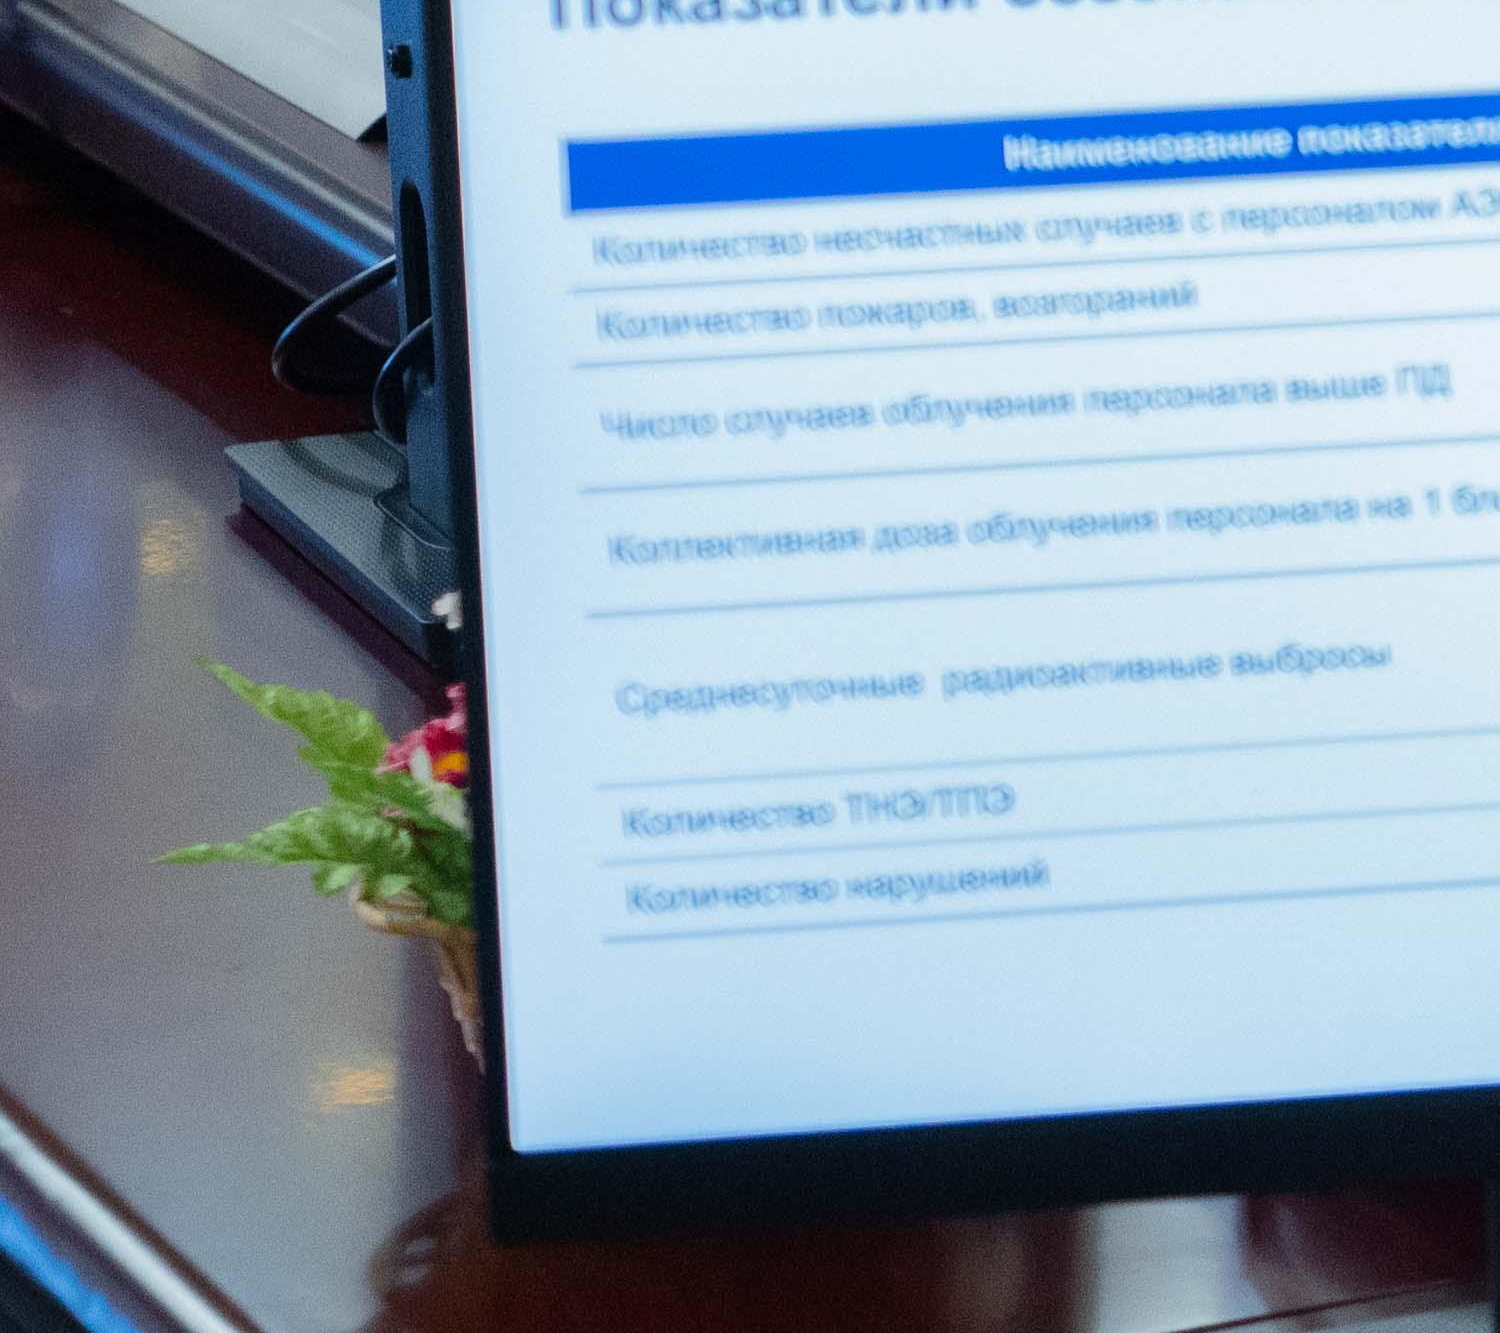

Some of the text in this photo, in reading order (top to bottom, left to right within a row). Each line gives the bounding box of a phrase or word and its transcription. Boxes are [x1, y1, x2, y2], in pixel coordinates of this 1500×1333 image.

[1002, 127, 1294, 172] Наименование
[593, 232, 808, 268] Количество
[814, 218, 1030, 255] несчастных
[1035, 209, 1183, 245] случаев
[1191, 208, 1216, 234] с
[1222, 197, 1443, 237] персоналом
[597, 306, 812, 341] Количество
[991, 279, 1198, 323] возгораний
[600, 407, 721, 443] Число
[725, 400, 873, 439] случаев
[882, 390, 1076, 431] облучения
[1083, 377, 1279, 417] персонала
[1286, 370, 1387, 402] выше
[608, 527, 867, 567] Коллективная
[872, 520, 959, 556] доза
[966, 507, 1158, 547] облучения
[1166, 494, 1360, 535] персонала
[1367, 493, 1412, 520] на
[1424, 485, 1442, 514] 1
[615, 641, 1391, 719] Среднесуточные радиоактивные выбросы
[622, 799, 837, 840] Количество
[625, 857, 1050, 916] Количество нарушений
